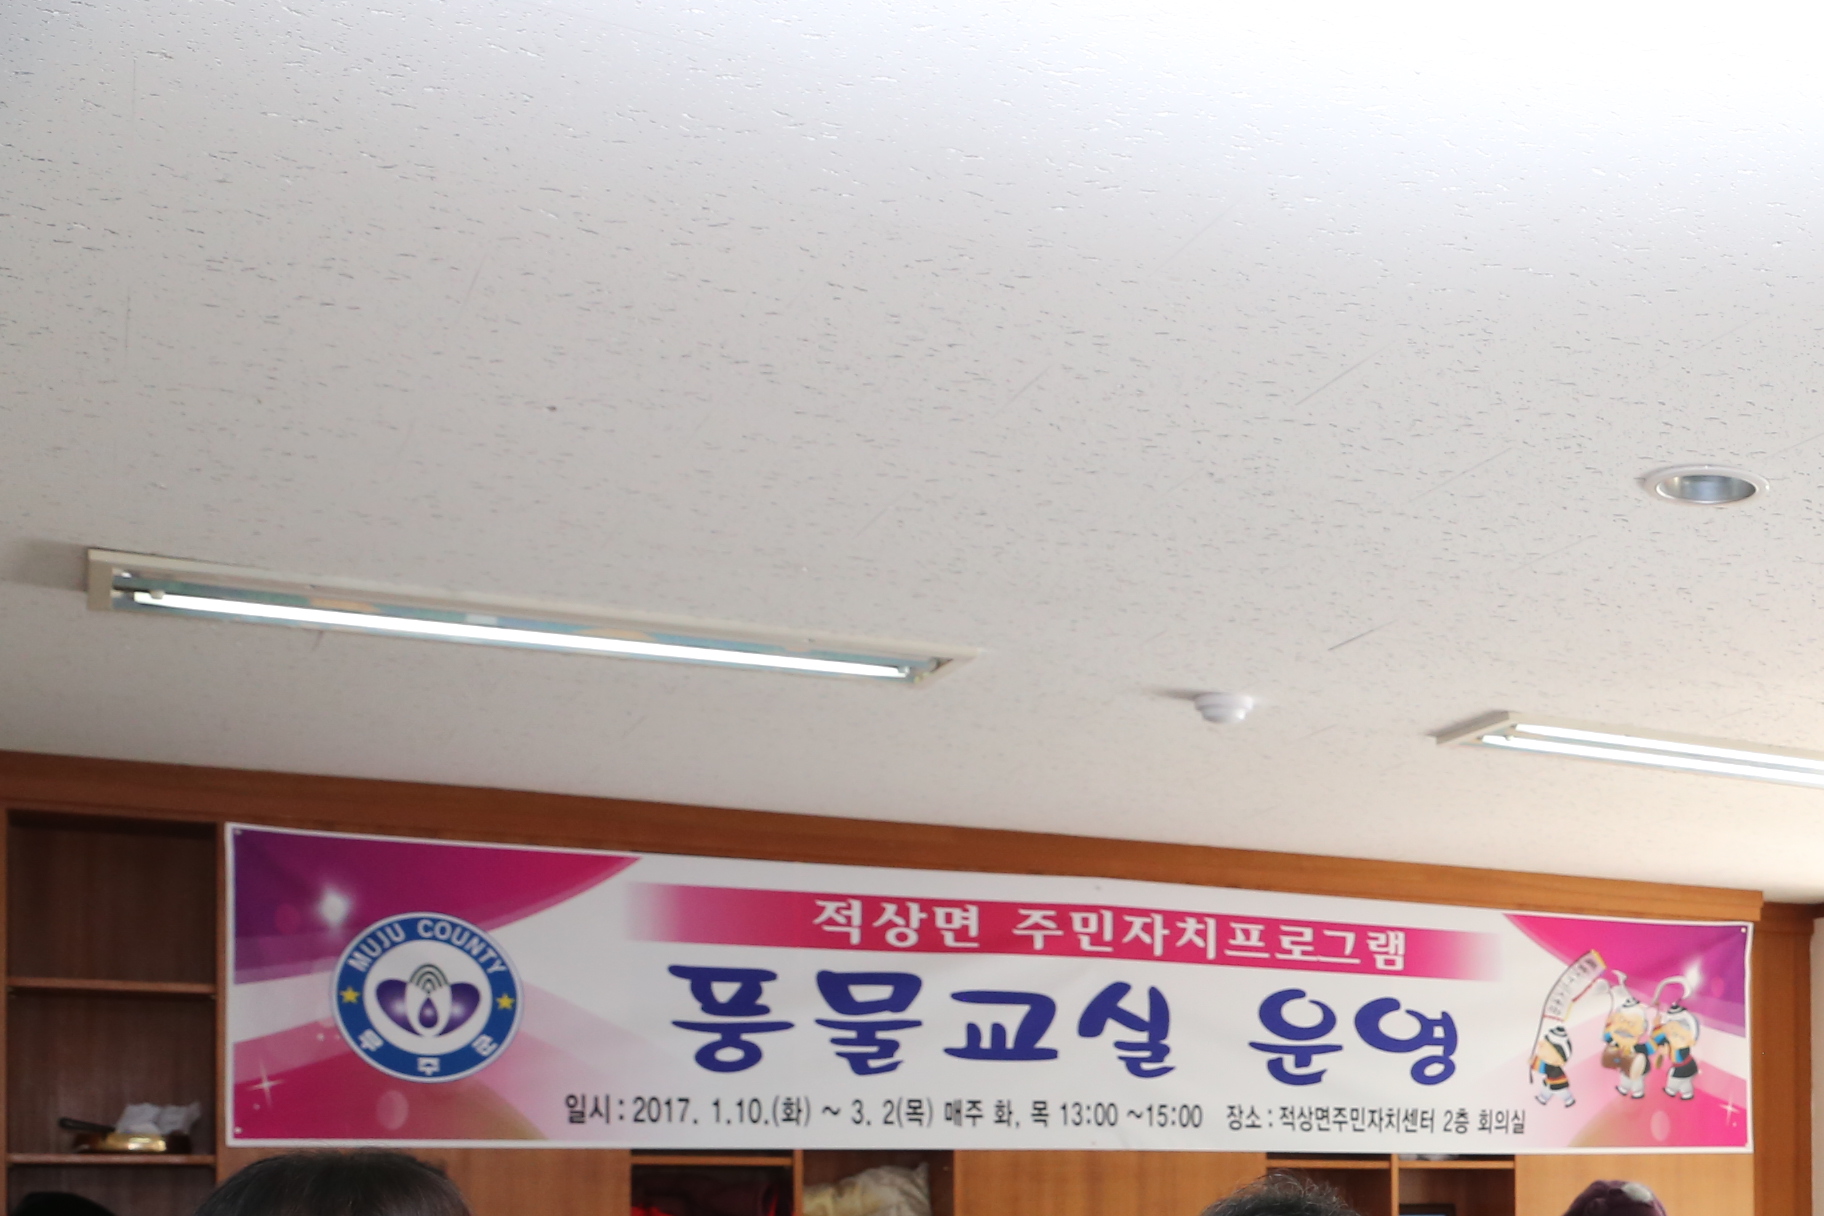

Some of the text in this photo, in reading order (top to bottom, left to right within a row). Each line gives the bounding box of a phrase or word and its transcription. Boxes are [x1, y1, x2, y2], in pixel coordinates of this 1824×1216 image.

[346, 918, 507, 974] MUJU COUNTY
[812, 898, 1407, 972] 적상면 주민자치프로그램
[667, 964, 1460, 1087] 풍물교실 운영
[632, 1096, 699, 1125] 2017.
[944, 1098, 984, 1129] 매주
[1031, 1100, 1051, 1129] 목
[1060, 1101, 1119, 1127] 13:00
[1279, 1105, 1436, 1134] 적상면주민자치센터
[1443, 1107, 1470, 1134] 2층
[1477, 1108, 1527, 1135] 회의실
